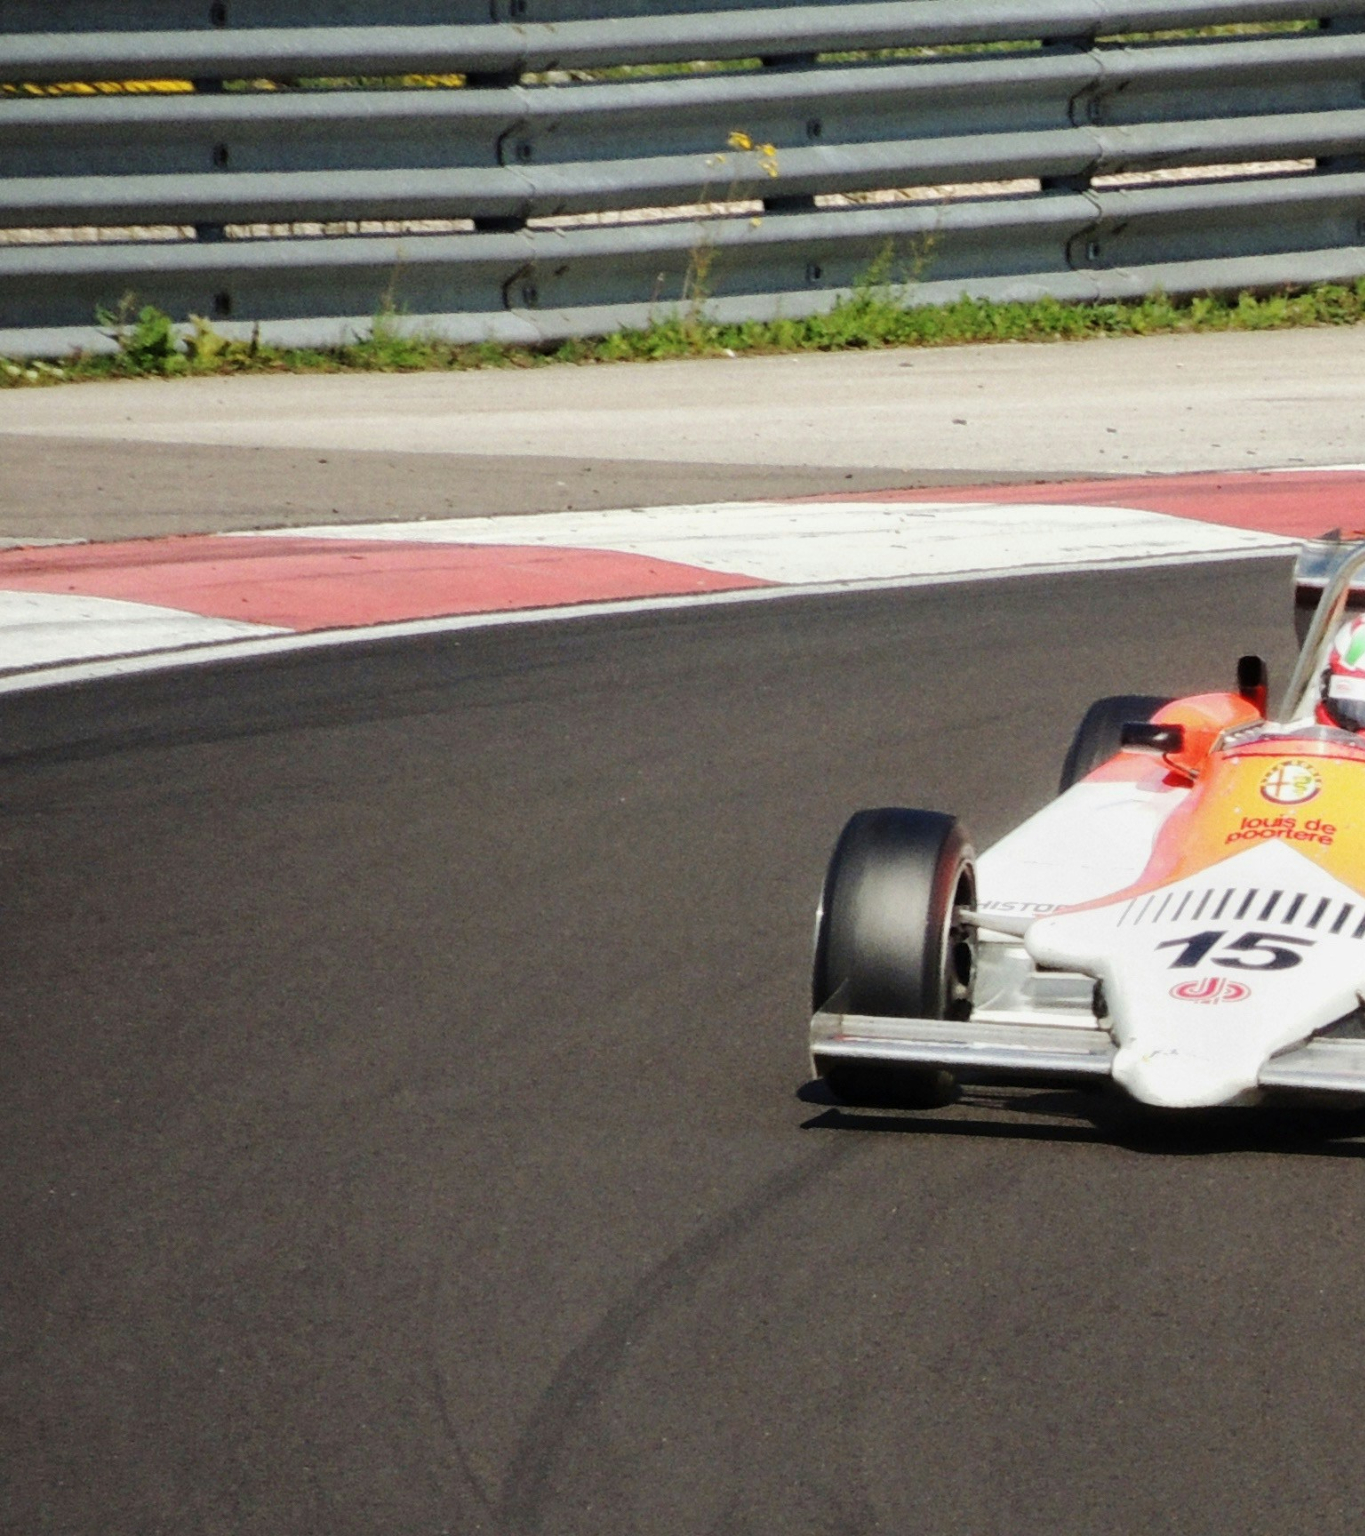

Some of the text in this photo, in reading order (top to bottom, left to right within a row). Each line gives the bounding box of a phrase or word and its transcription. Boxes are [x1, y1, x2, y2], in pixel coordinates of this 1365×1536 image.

[1240, 815, 1337, 835] louis de
[1224, 828, 1334, 845] poortere
[1154, 930, 1319, 971] 15
